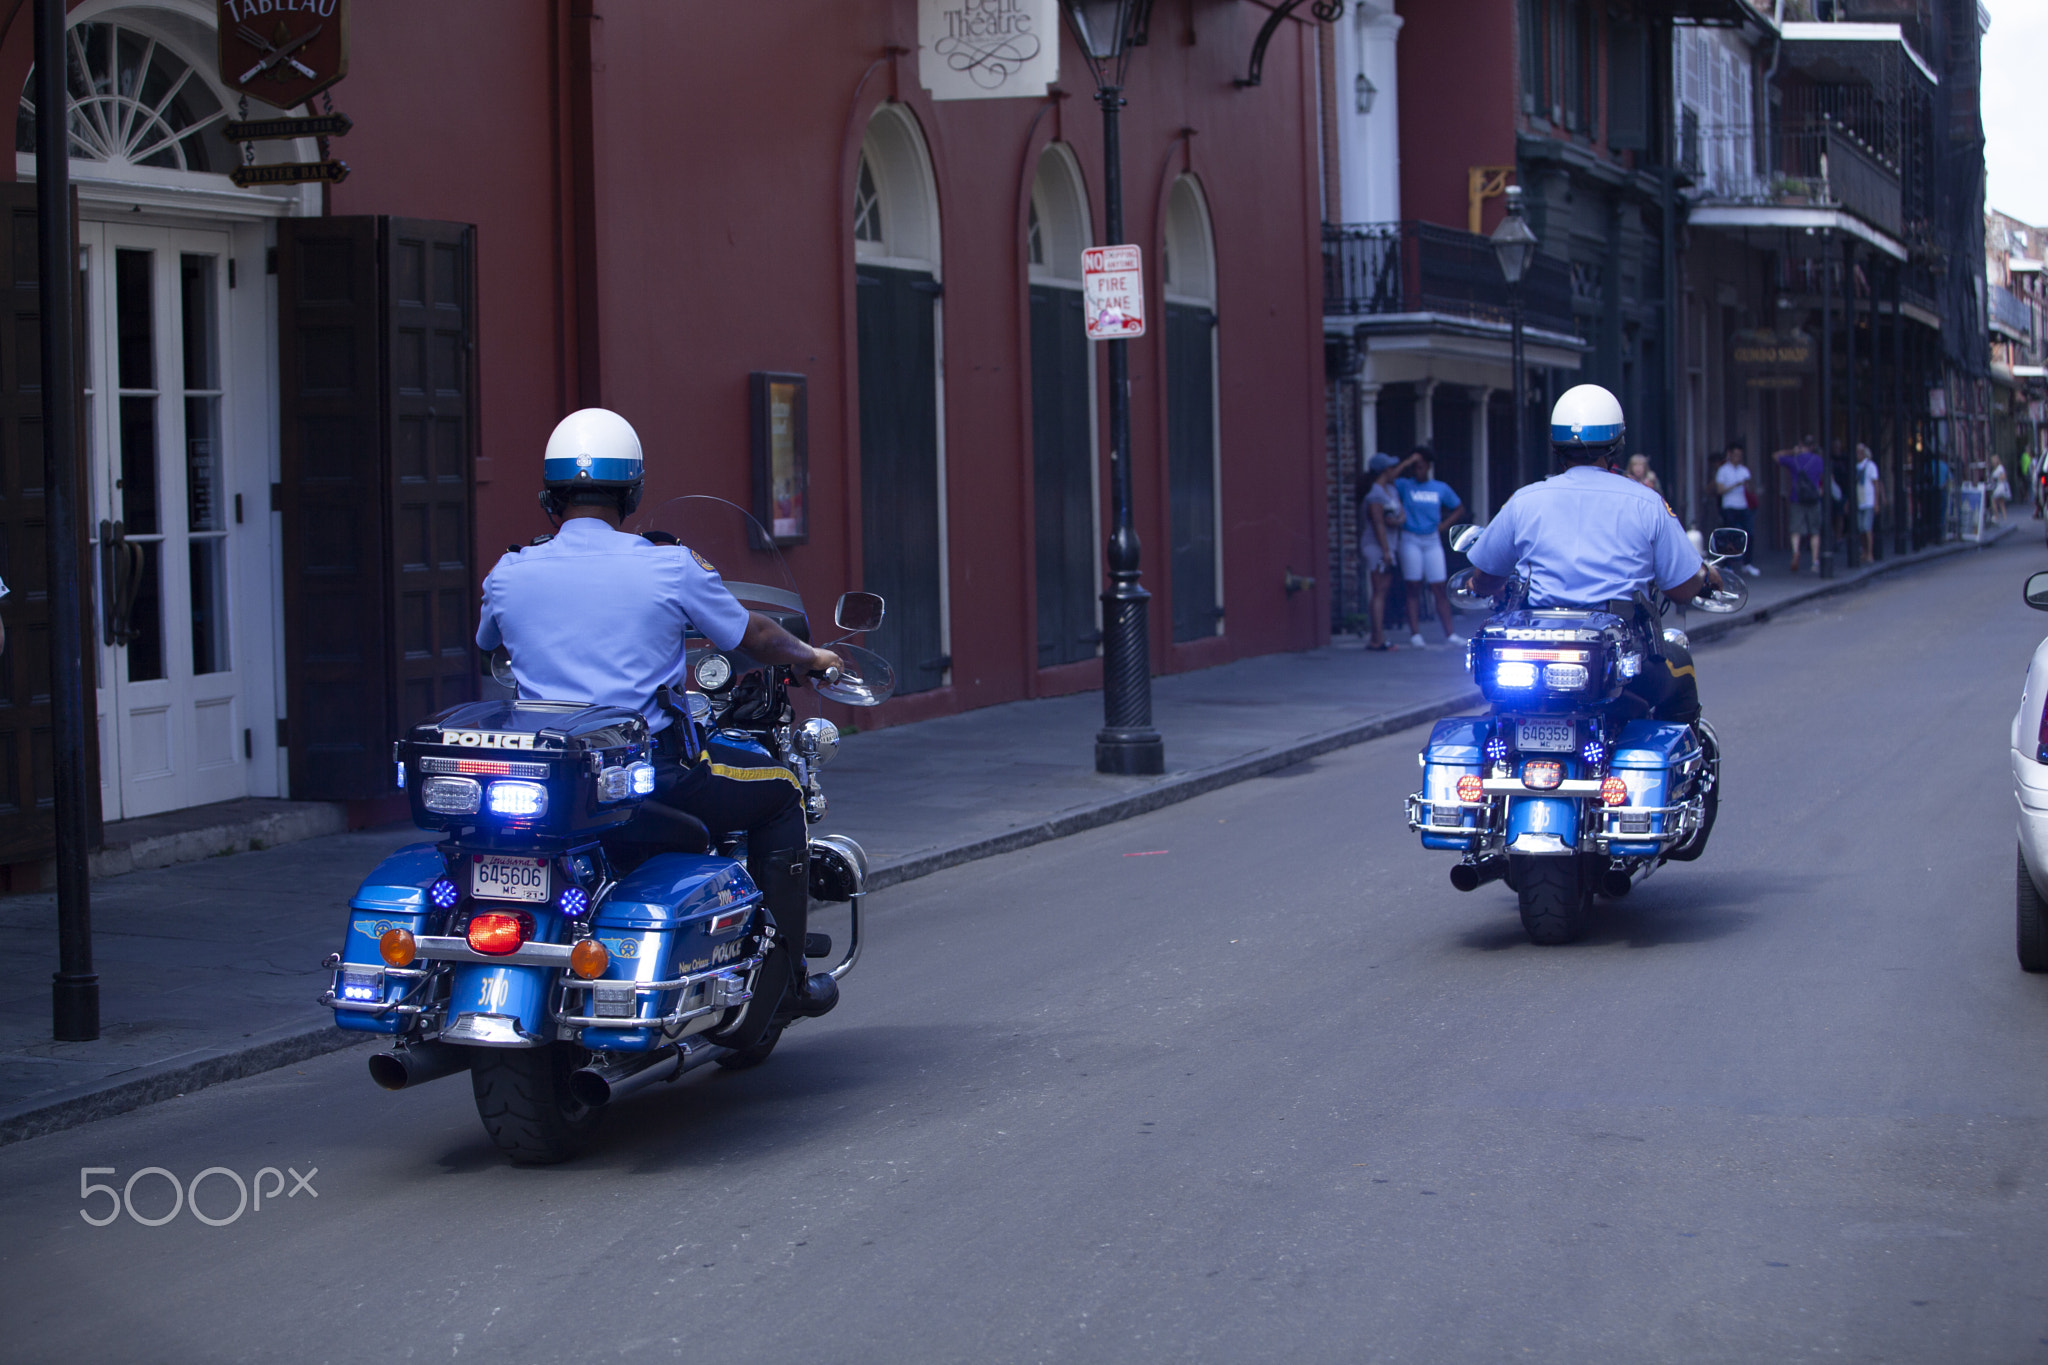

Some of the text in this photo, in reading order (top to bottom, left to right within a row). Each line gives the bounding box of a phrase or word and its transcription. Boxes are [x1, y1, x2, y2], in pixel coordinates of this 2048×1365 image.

[245, 166, 328, 182] OYSTER BAR
[1085, 253, 1103, 271] NO
[1098, 277, 1127, 292] FIRE
[1097, 296, 1131, 310] LANE
[1506, 629, 1576, 640] POLICE
[442, 731, 535, 750] POLICE
[1522, 726, 1569, 741] 646359
[489, 856, 534, 867] Louisiana
[480, 864, 541, 887] 645606
[503, 886, 517, 895] MC
[679, 962, 692, 974] New
[712, 940, 741, 965] POLICE
